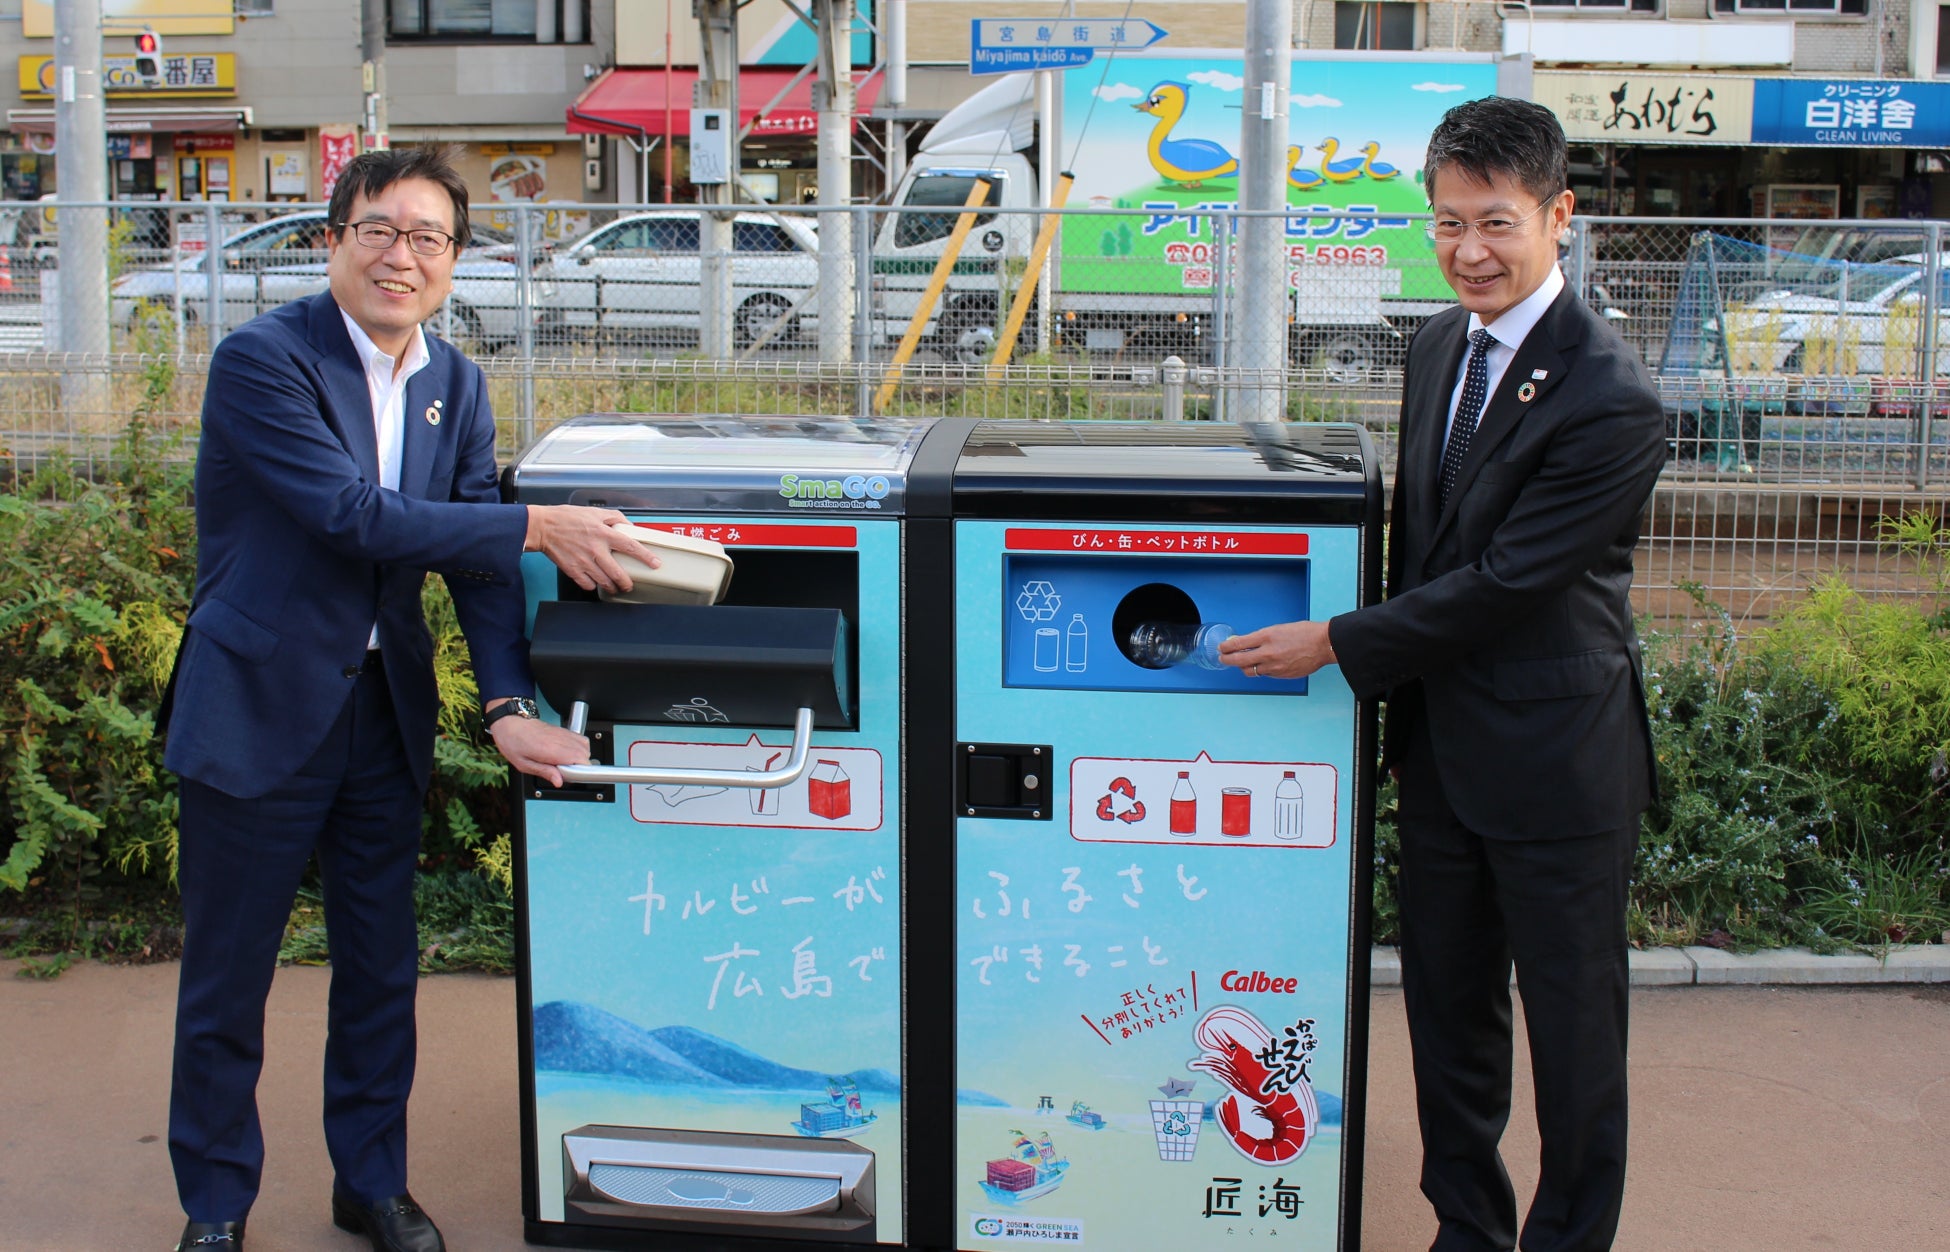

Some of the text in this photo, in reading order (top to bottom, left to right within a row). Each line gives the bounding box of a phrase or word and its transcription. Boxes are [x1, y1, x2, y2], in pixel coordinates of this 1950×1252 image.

[999, 25, 1127, 43] 宮島街道
[975, 49, 1030, 65] Miyajima
[1823, 84, 1901, 98] クリーニング
[1603, 81, 1718, 136] あわむら
[1805, 99, 1916, 130] 白洋舎
[1815, 130, 1903, 143] CLEAN LIVING
[779, 474, 891, 500] SmaGO
[788, 499, 813, 508] Smart
[814, 500, 839, 508] action
[851, 500, 865, 508] the
[1072, 533, 1240, 550] びん・缶・ペットボトル
[628, 866, 886, 936] カルビーが
[972, 863, 1208, 920] ふるさと
[970, 935, 1169, 986] できること
[703, 936, 886, 1011] 広島で
[1220, 970, 1299, 994] Calbee
[1119, 983, 1157, 1007] 正しく
[1101, 987, 1187, 1031] 分別してくれて
[1295, 1019, 1319, 1052] かっぱ
[1202, 1177, 1305, 1220] 匠海
[1005, 1228, 1079, 1240] 瀬戸内ひろしま宣言
[1226, 1226, 1279, 1237] たくみ
